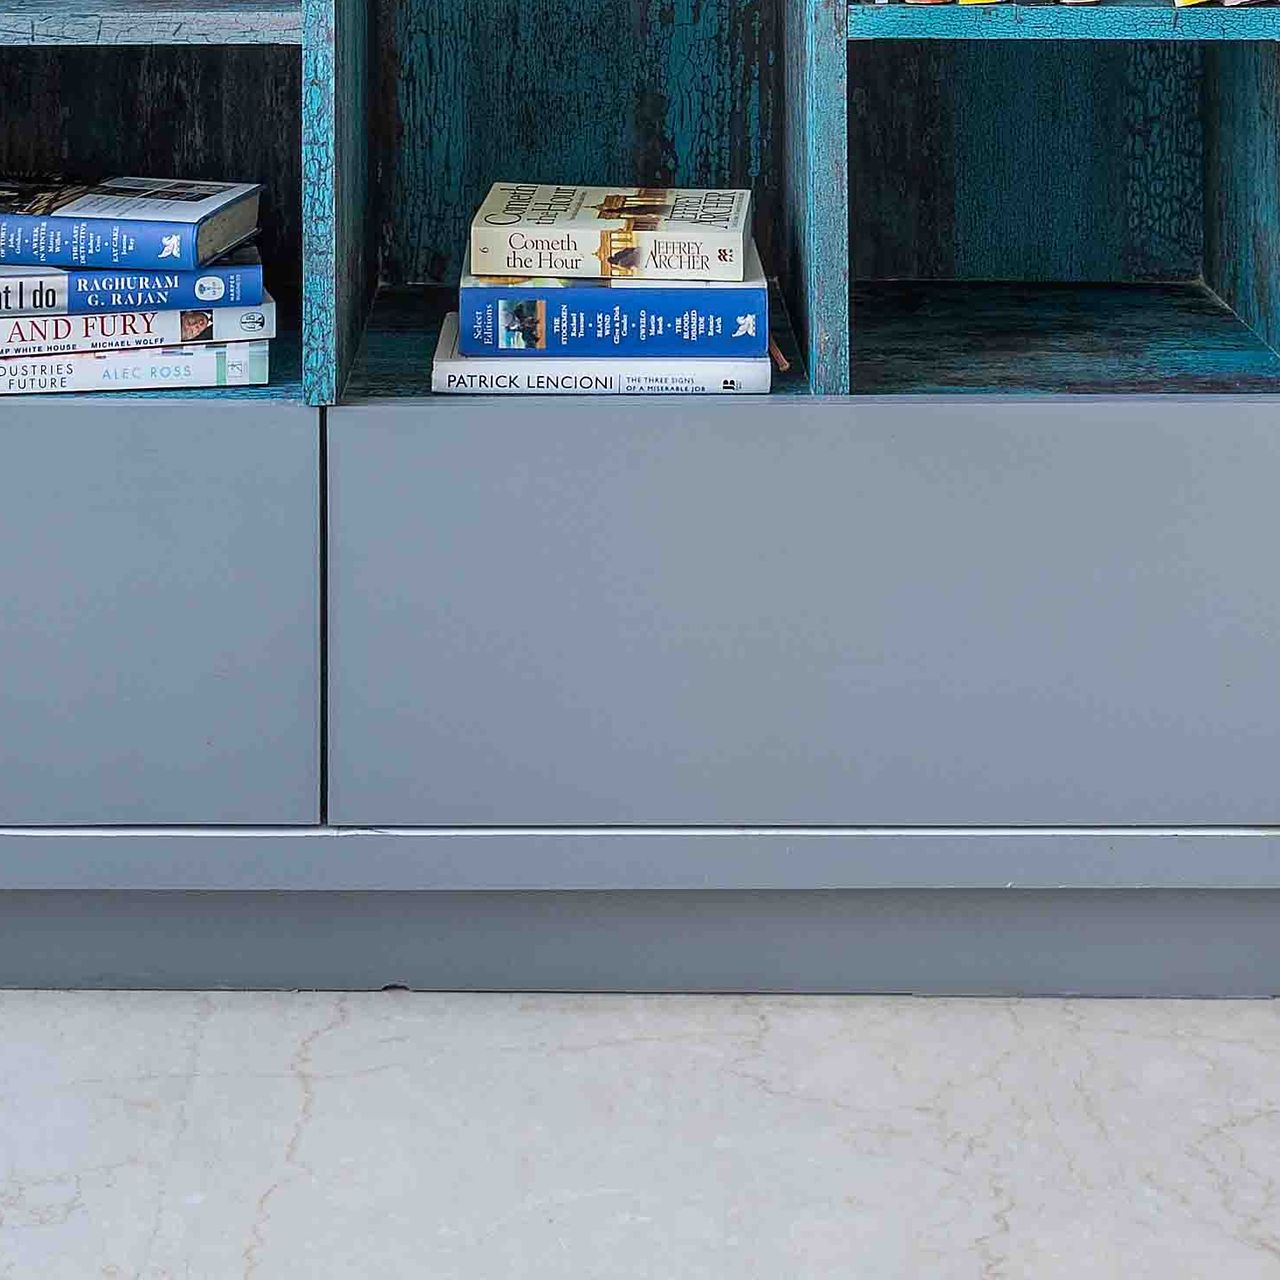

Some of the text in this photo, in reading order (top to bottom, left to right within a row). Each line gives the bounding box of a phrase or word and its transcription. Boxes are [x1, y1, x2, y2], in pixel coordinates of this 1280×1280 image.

[508, 233, 578, 251] Cometh
[652, 239, 704, 256] JEFFREY
[506, 252, 581, 269] the Hour
[645, 251, 710, 270] ARCHER
[76, 275, 179, 291] RAGHURAM
[32, 282, 56, 308] do
[88, 292, 170, 306] G. RAJAN
[8, 318, 72, 342] AND
[82, 312, 158, 338] FURY
[14, 346, 43, 354] WHITE
[47, 344, 77, 352] HOUSE
[91, 339, 131, 348] MICHAEL
[135, 338, 165, 346] WOLFF
[8, 377, 68, 390] FUTURE
[448, 375, 614, 389] PATRICK LENCIONI
